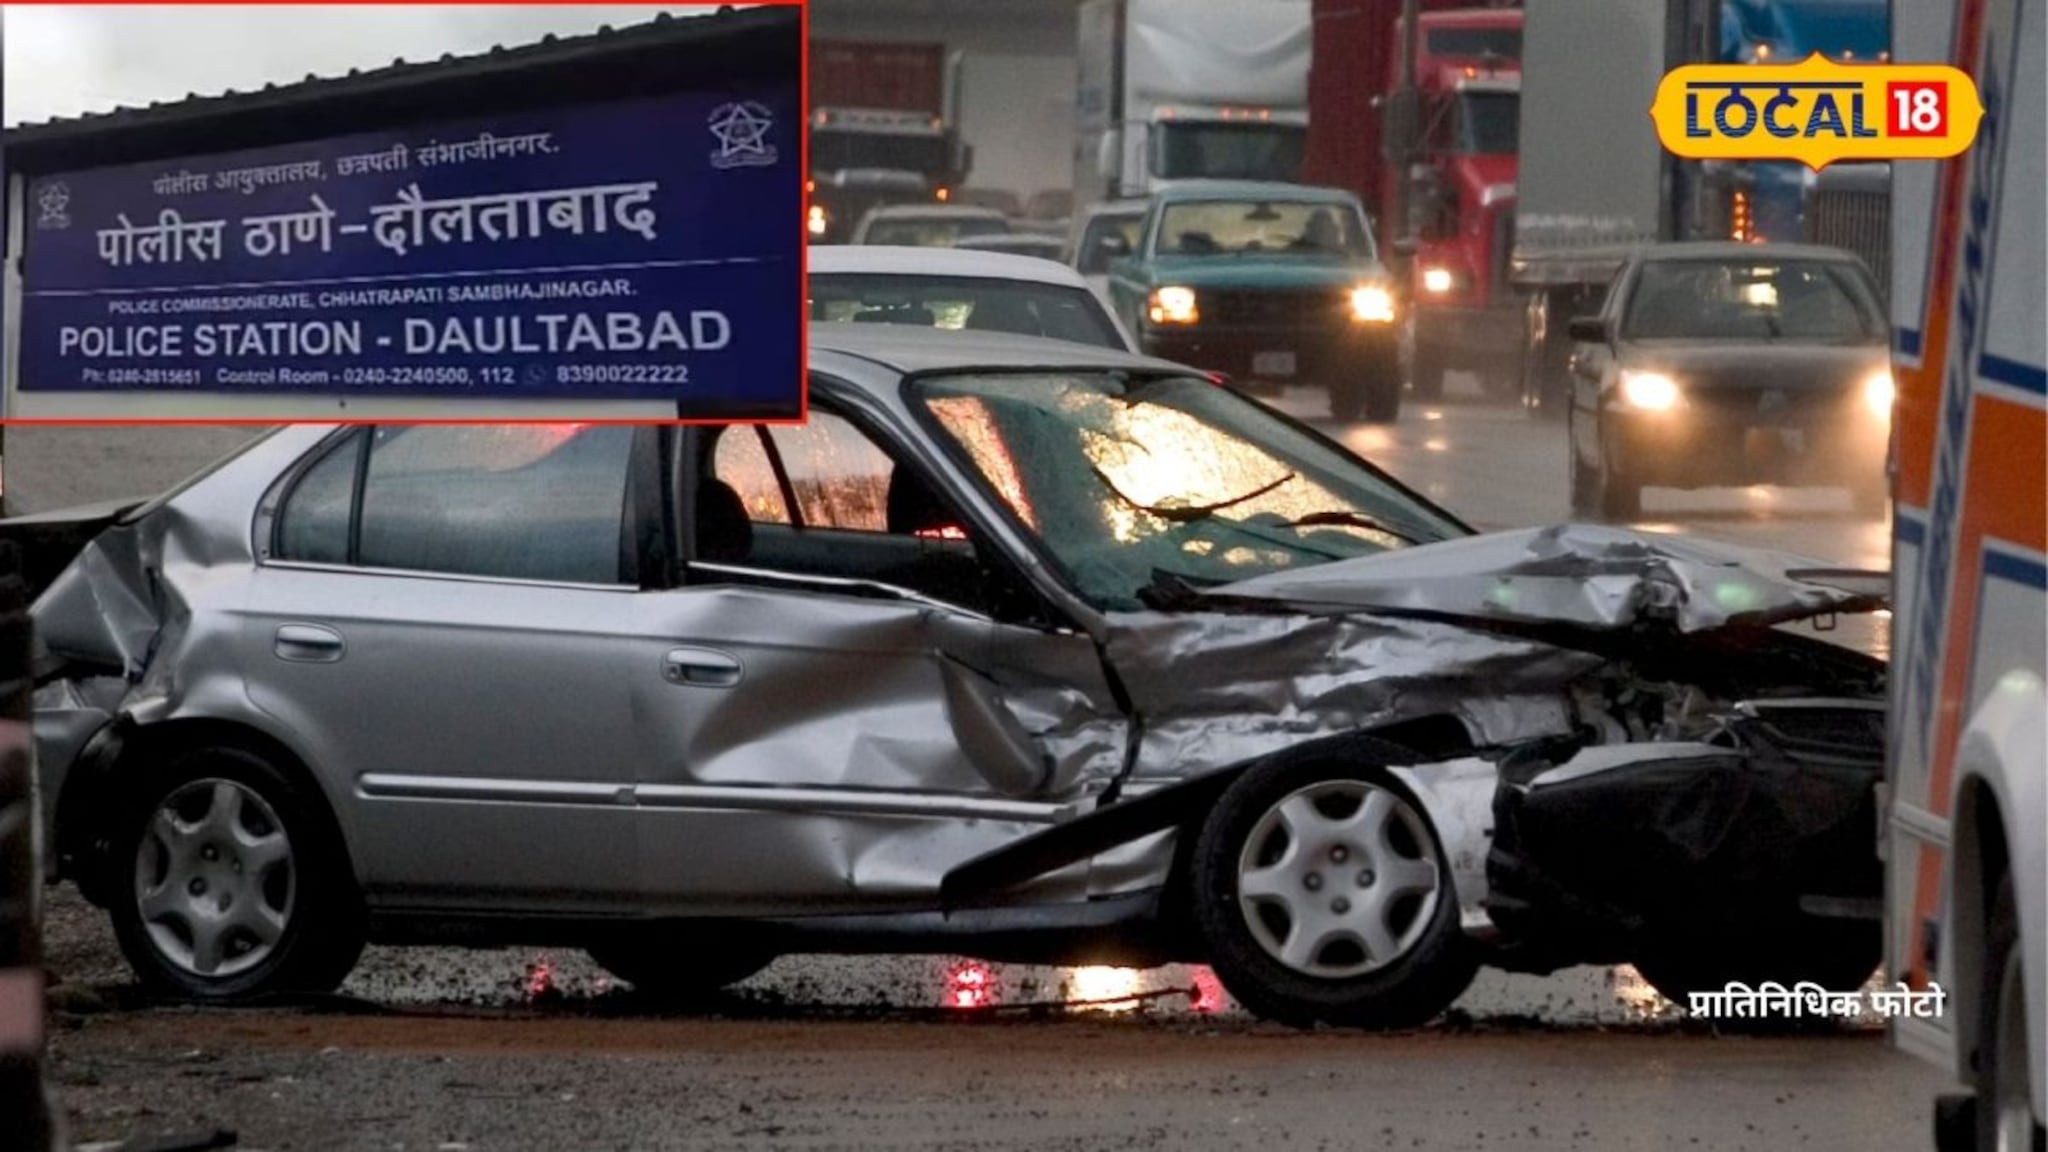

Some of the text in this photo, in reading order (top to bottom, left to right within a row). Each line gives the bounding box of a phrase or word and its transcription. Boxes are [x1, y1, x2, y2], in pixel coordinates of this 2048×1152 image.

[153, 170, 208, 196] पोलीस
[337, 144, 409, 176] छत्रपती
[416, 131, 560, 167] संभाजीनगर.
[97, 208, 227, 266] पोलीस
[108, 278, 637, 315] POLICE COMMISSIONERATE, CHHATRAPATI SAMBHAJINAGAR.
[59, 326, 182, 358] POLICE
[193, 320, 363, 357] STATION
[404, 310, 731, 355] DAULTABAD
[217, 367, 276, 384] Control
[279, 367, 328, 384] Room
[343, 366, 473, 386] 0240-2240500,
[480, 367, 516, 384] 112
[557, 365, 690, 383] 8390022222
